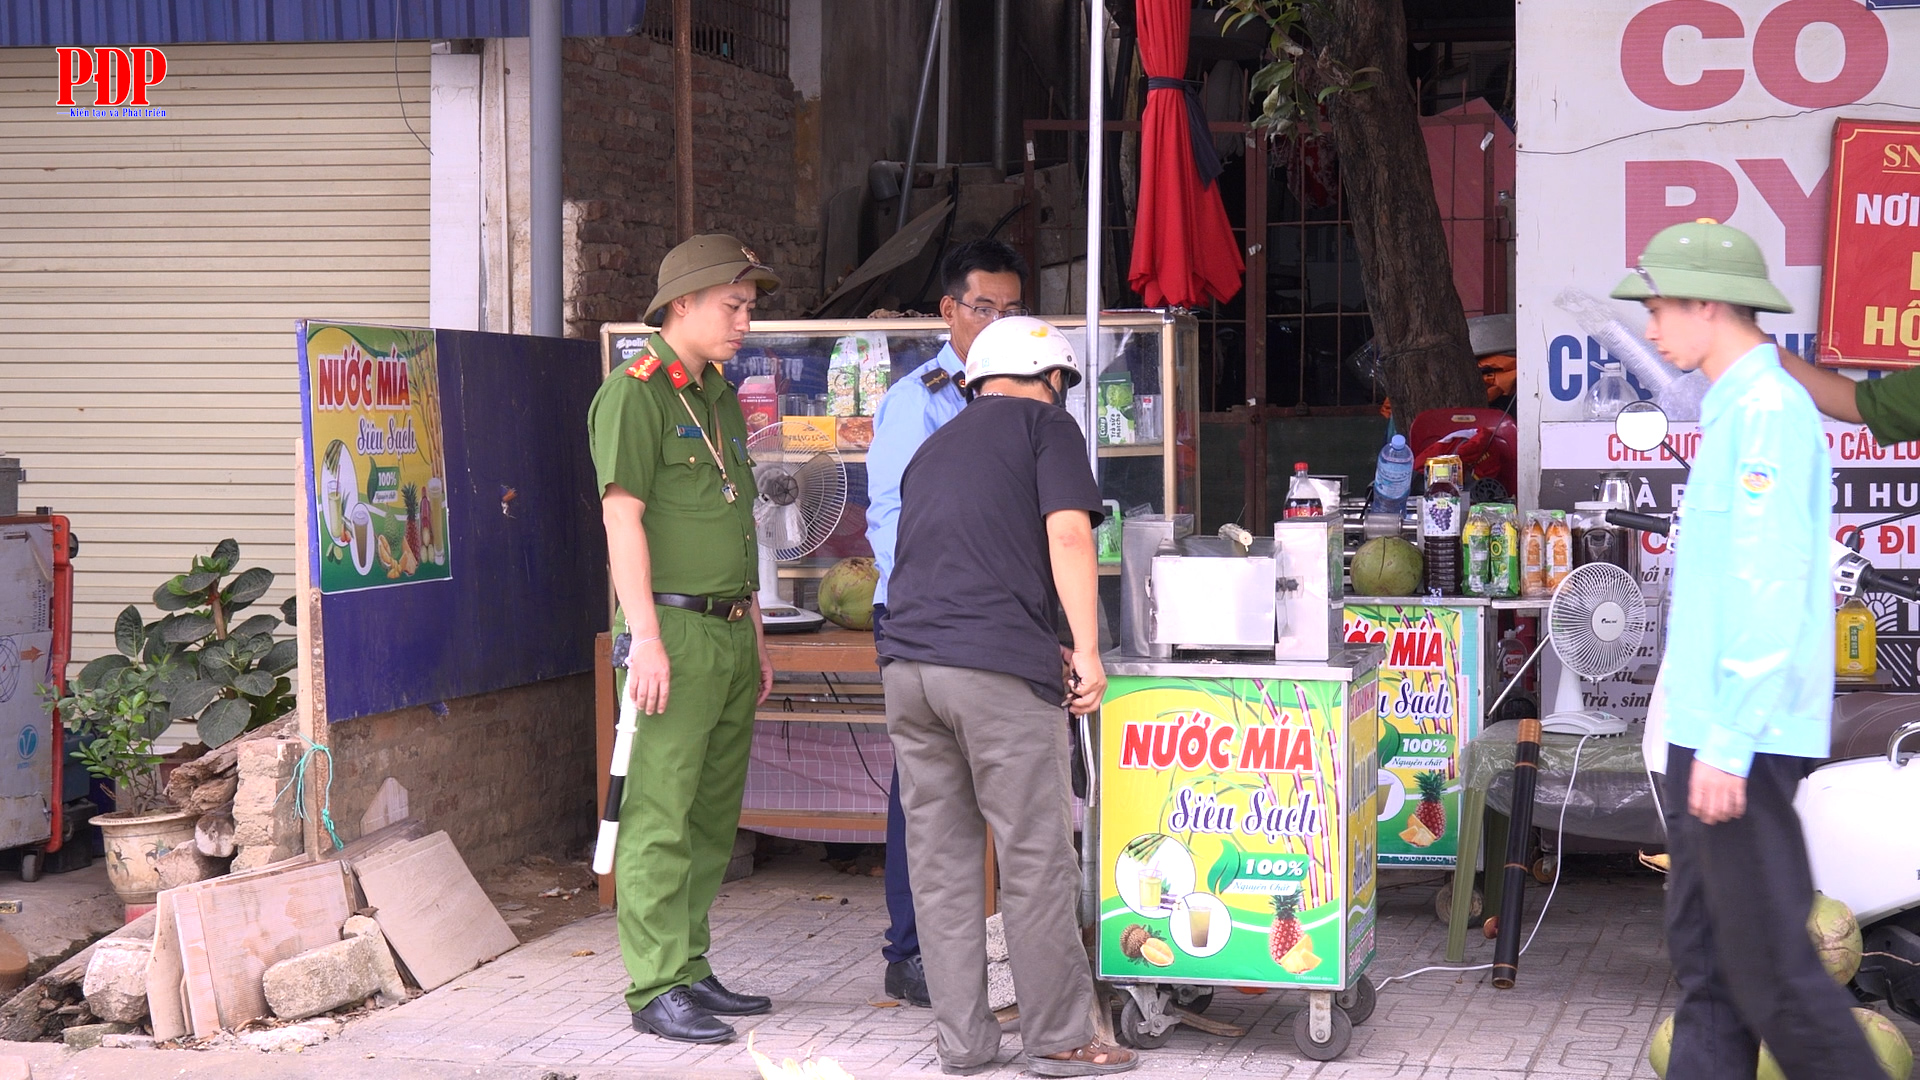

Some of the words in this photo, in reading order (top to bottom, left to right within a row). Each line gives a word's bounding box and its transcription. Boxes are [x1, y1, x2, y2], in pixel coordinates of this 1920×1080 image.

[318, 344, 373, 407] NƯỚC
[376, 346, 410, 406] MÍA
[357, 418, 383, 451] Siêu
[387, 419, 416, 456] Sạch
[378, 471, 397, 487] 100%
[1389, 621, 1444, 667] MÍA
[1395, 682, 1451, 721] Sạch
[1582, 692, 1608, 708] Trà
[1121, 711, 1235, 770] NƯỚC
[1239, 714, 1314, 771] MÍA
[1402, 738, 1447, 753] 100%
[1172, 788, 1235, 831] Siêu
[1245, 790, 1321, 844] Sạch
[1245, 858, 1303, 877] 100%
